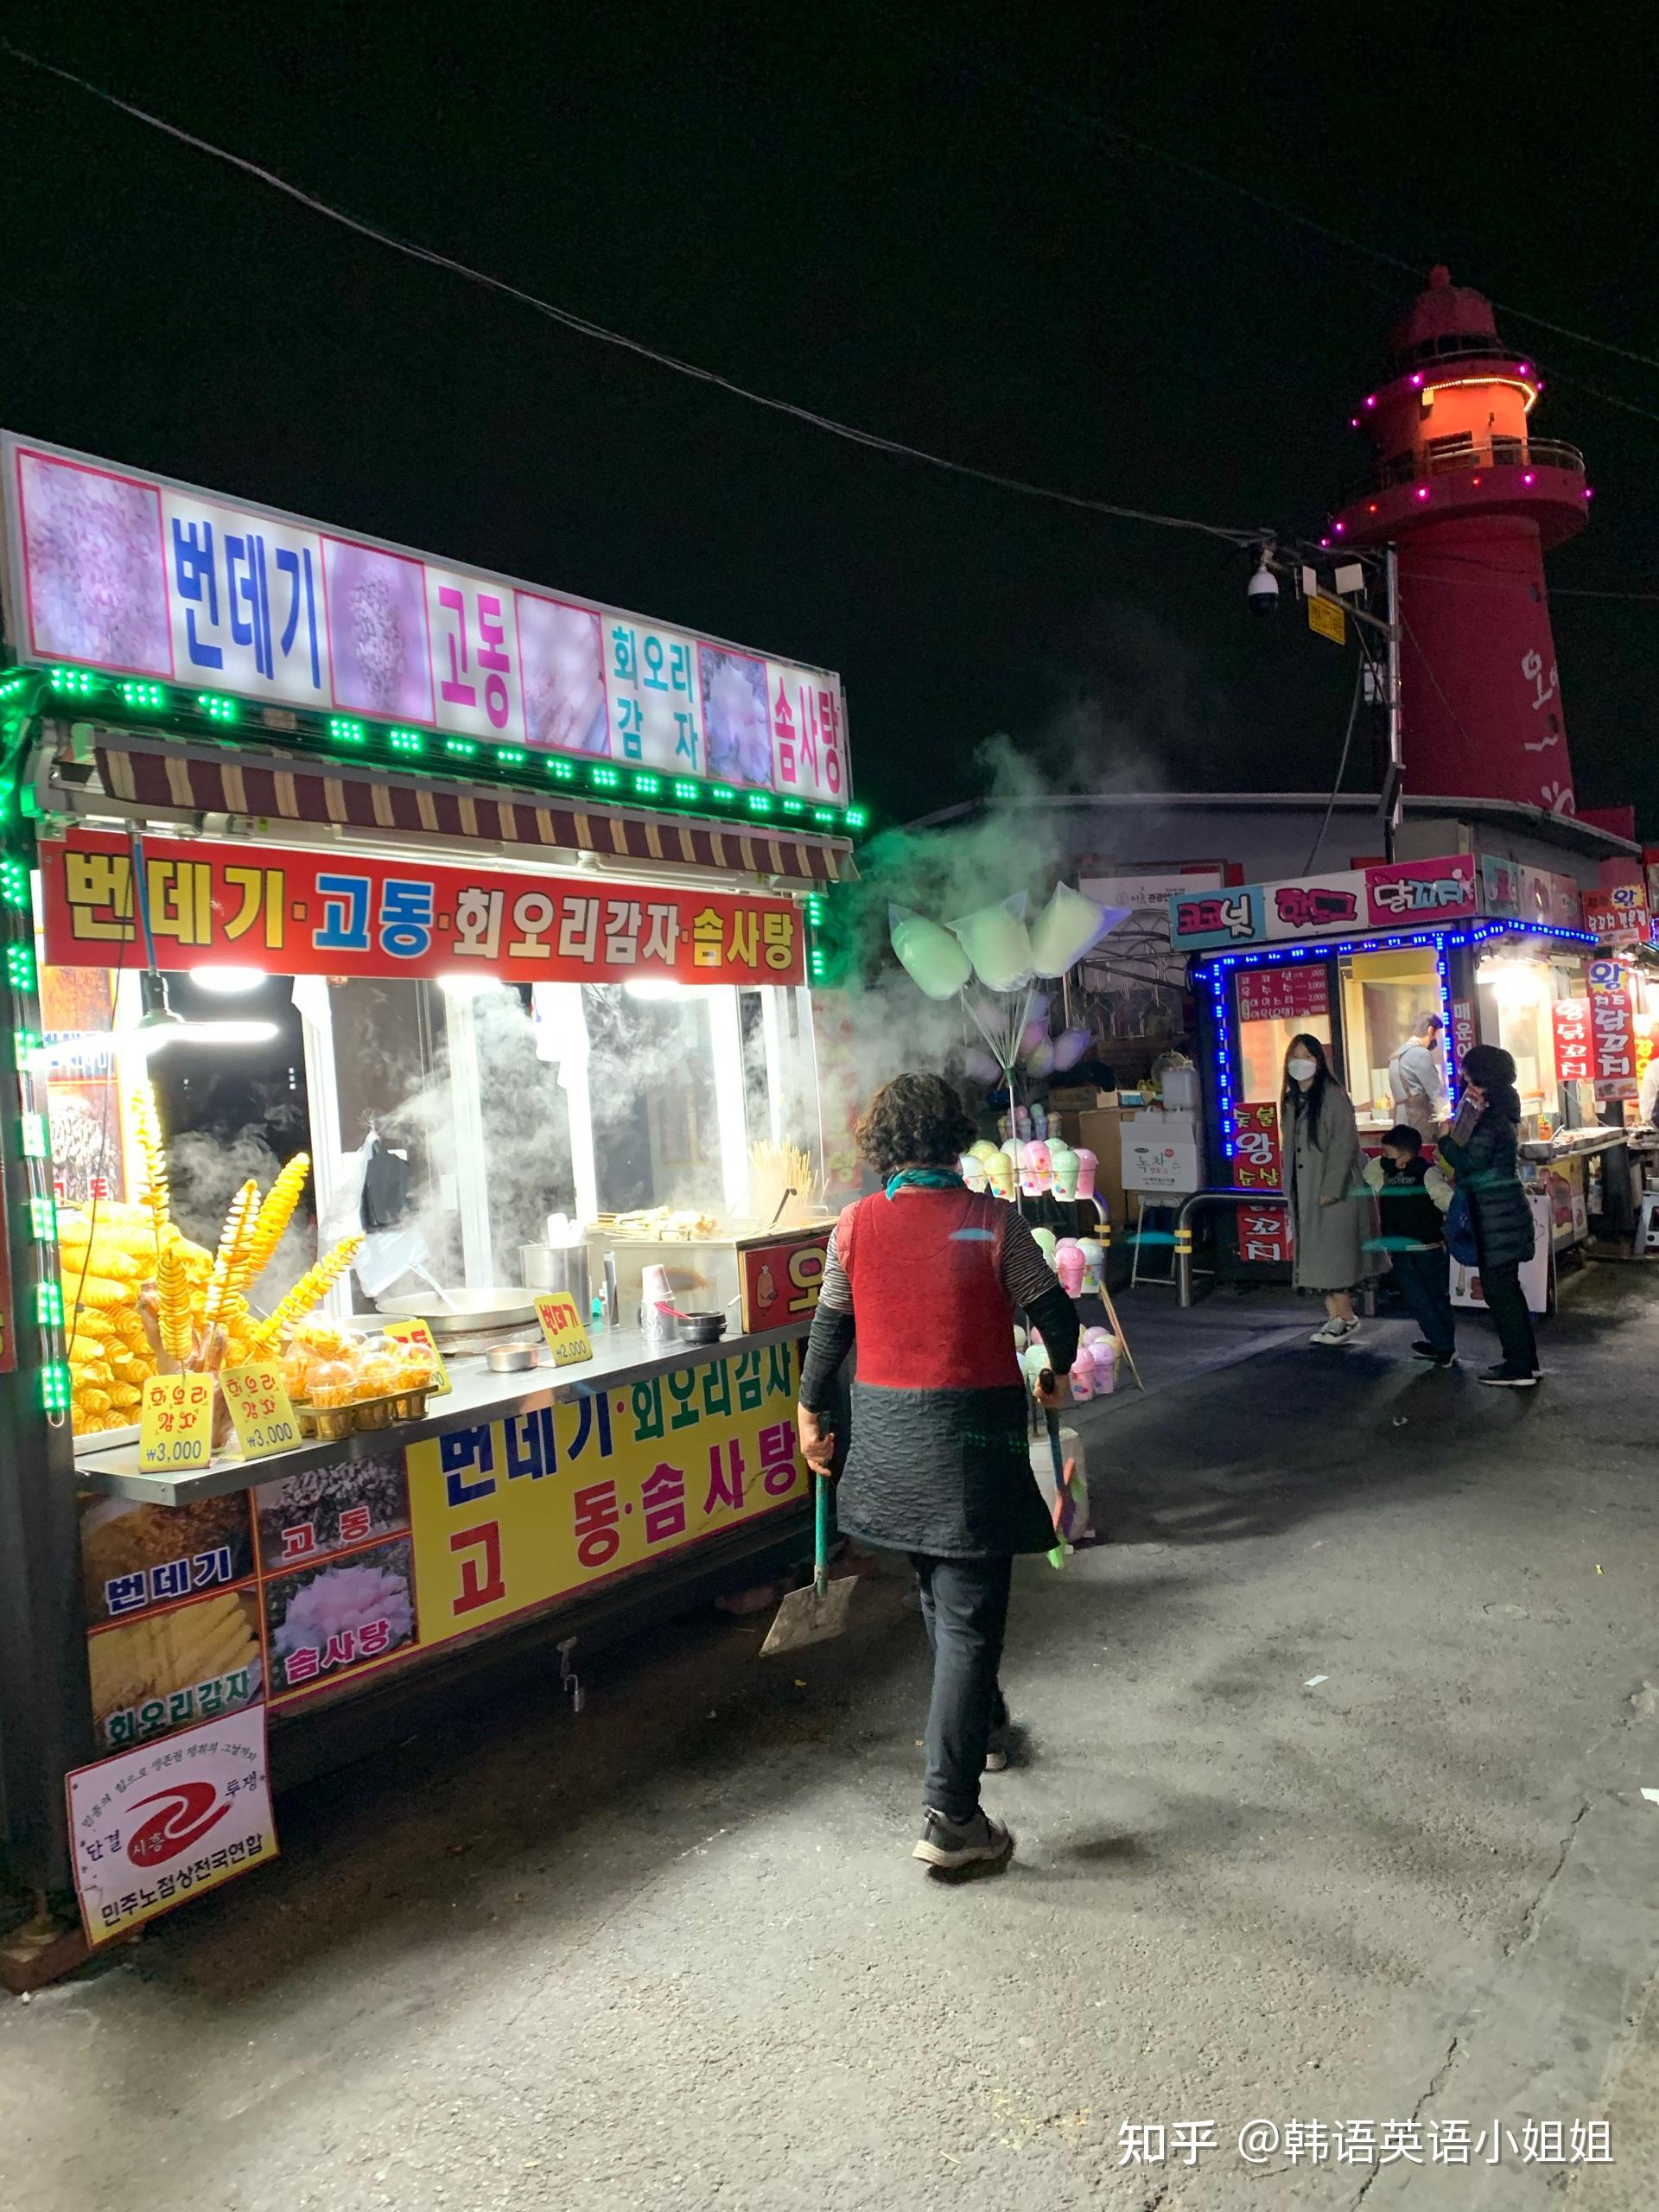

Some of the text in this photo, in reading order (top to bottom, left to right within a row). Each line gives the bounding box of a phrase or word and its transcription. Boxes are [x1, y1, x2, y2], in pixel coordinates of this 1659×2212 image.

[172, 518, 321, 689] 번데기
[438, 586, 511, 728] 고동
[612, 626, 693, 703] 회오리
[774, 676, 840, 795] 솜사탕
[1178, 894, 1255, 939] 코코넛
[1590, 963, 1626, 990] 왕
[1236, 1133, 1275, 1165] 왕
[538, 1303, 579, 1336] 번데기
[149, 1385, 207, 1407] 회오리
[226, 1373, 276, 1397] 회오리
[105, 1547, 232, 1615] 번데기
[284, 1618, 391, 1684] 솜사탕
[108, 1667, 250, 1747] 회오리감자
[86, 1829, 123, 1862] 단결
